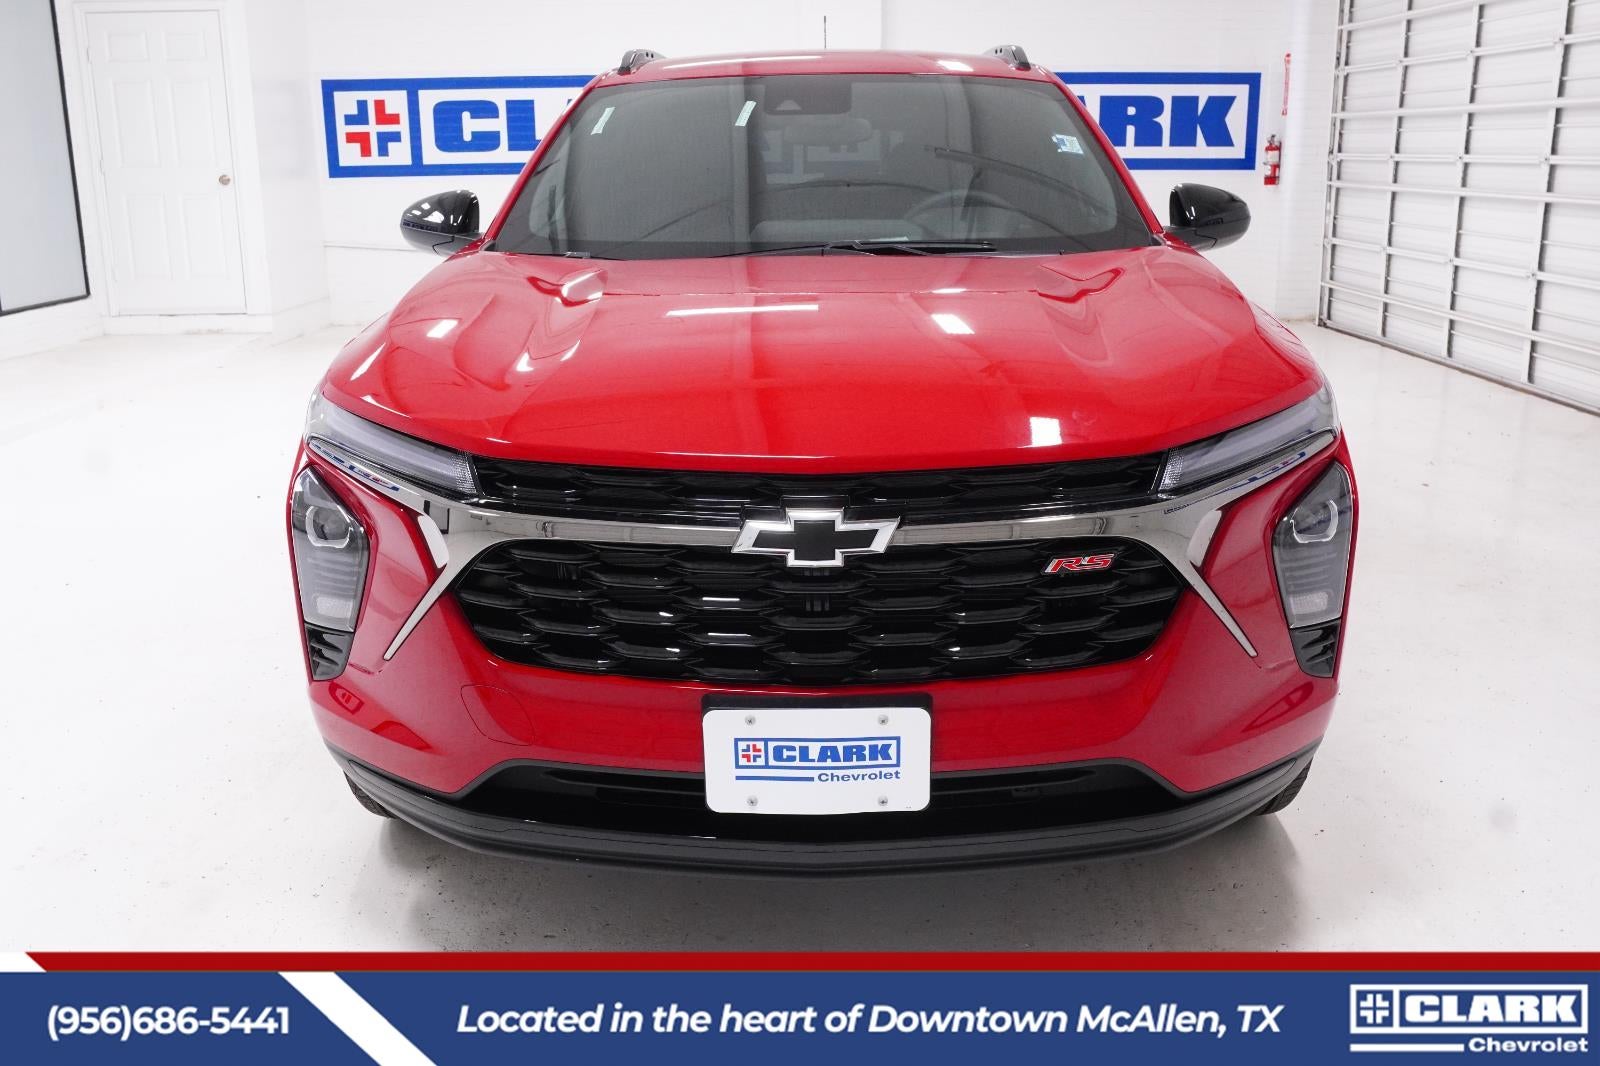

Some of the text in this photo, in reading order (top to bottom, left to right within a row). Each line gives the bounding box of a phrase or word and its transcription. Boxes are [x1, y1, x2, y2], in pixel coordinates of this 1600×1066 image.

[1044, 553, 1115, 573] RS
[772, 743, 893, 763] CLARK
[817, 770, 901, 783] Chevrolet
